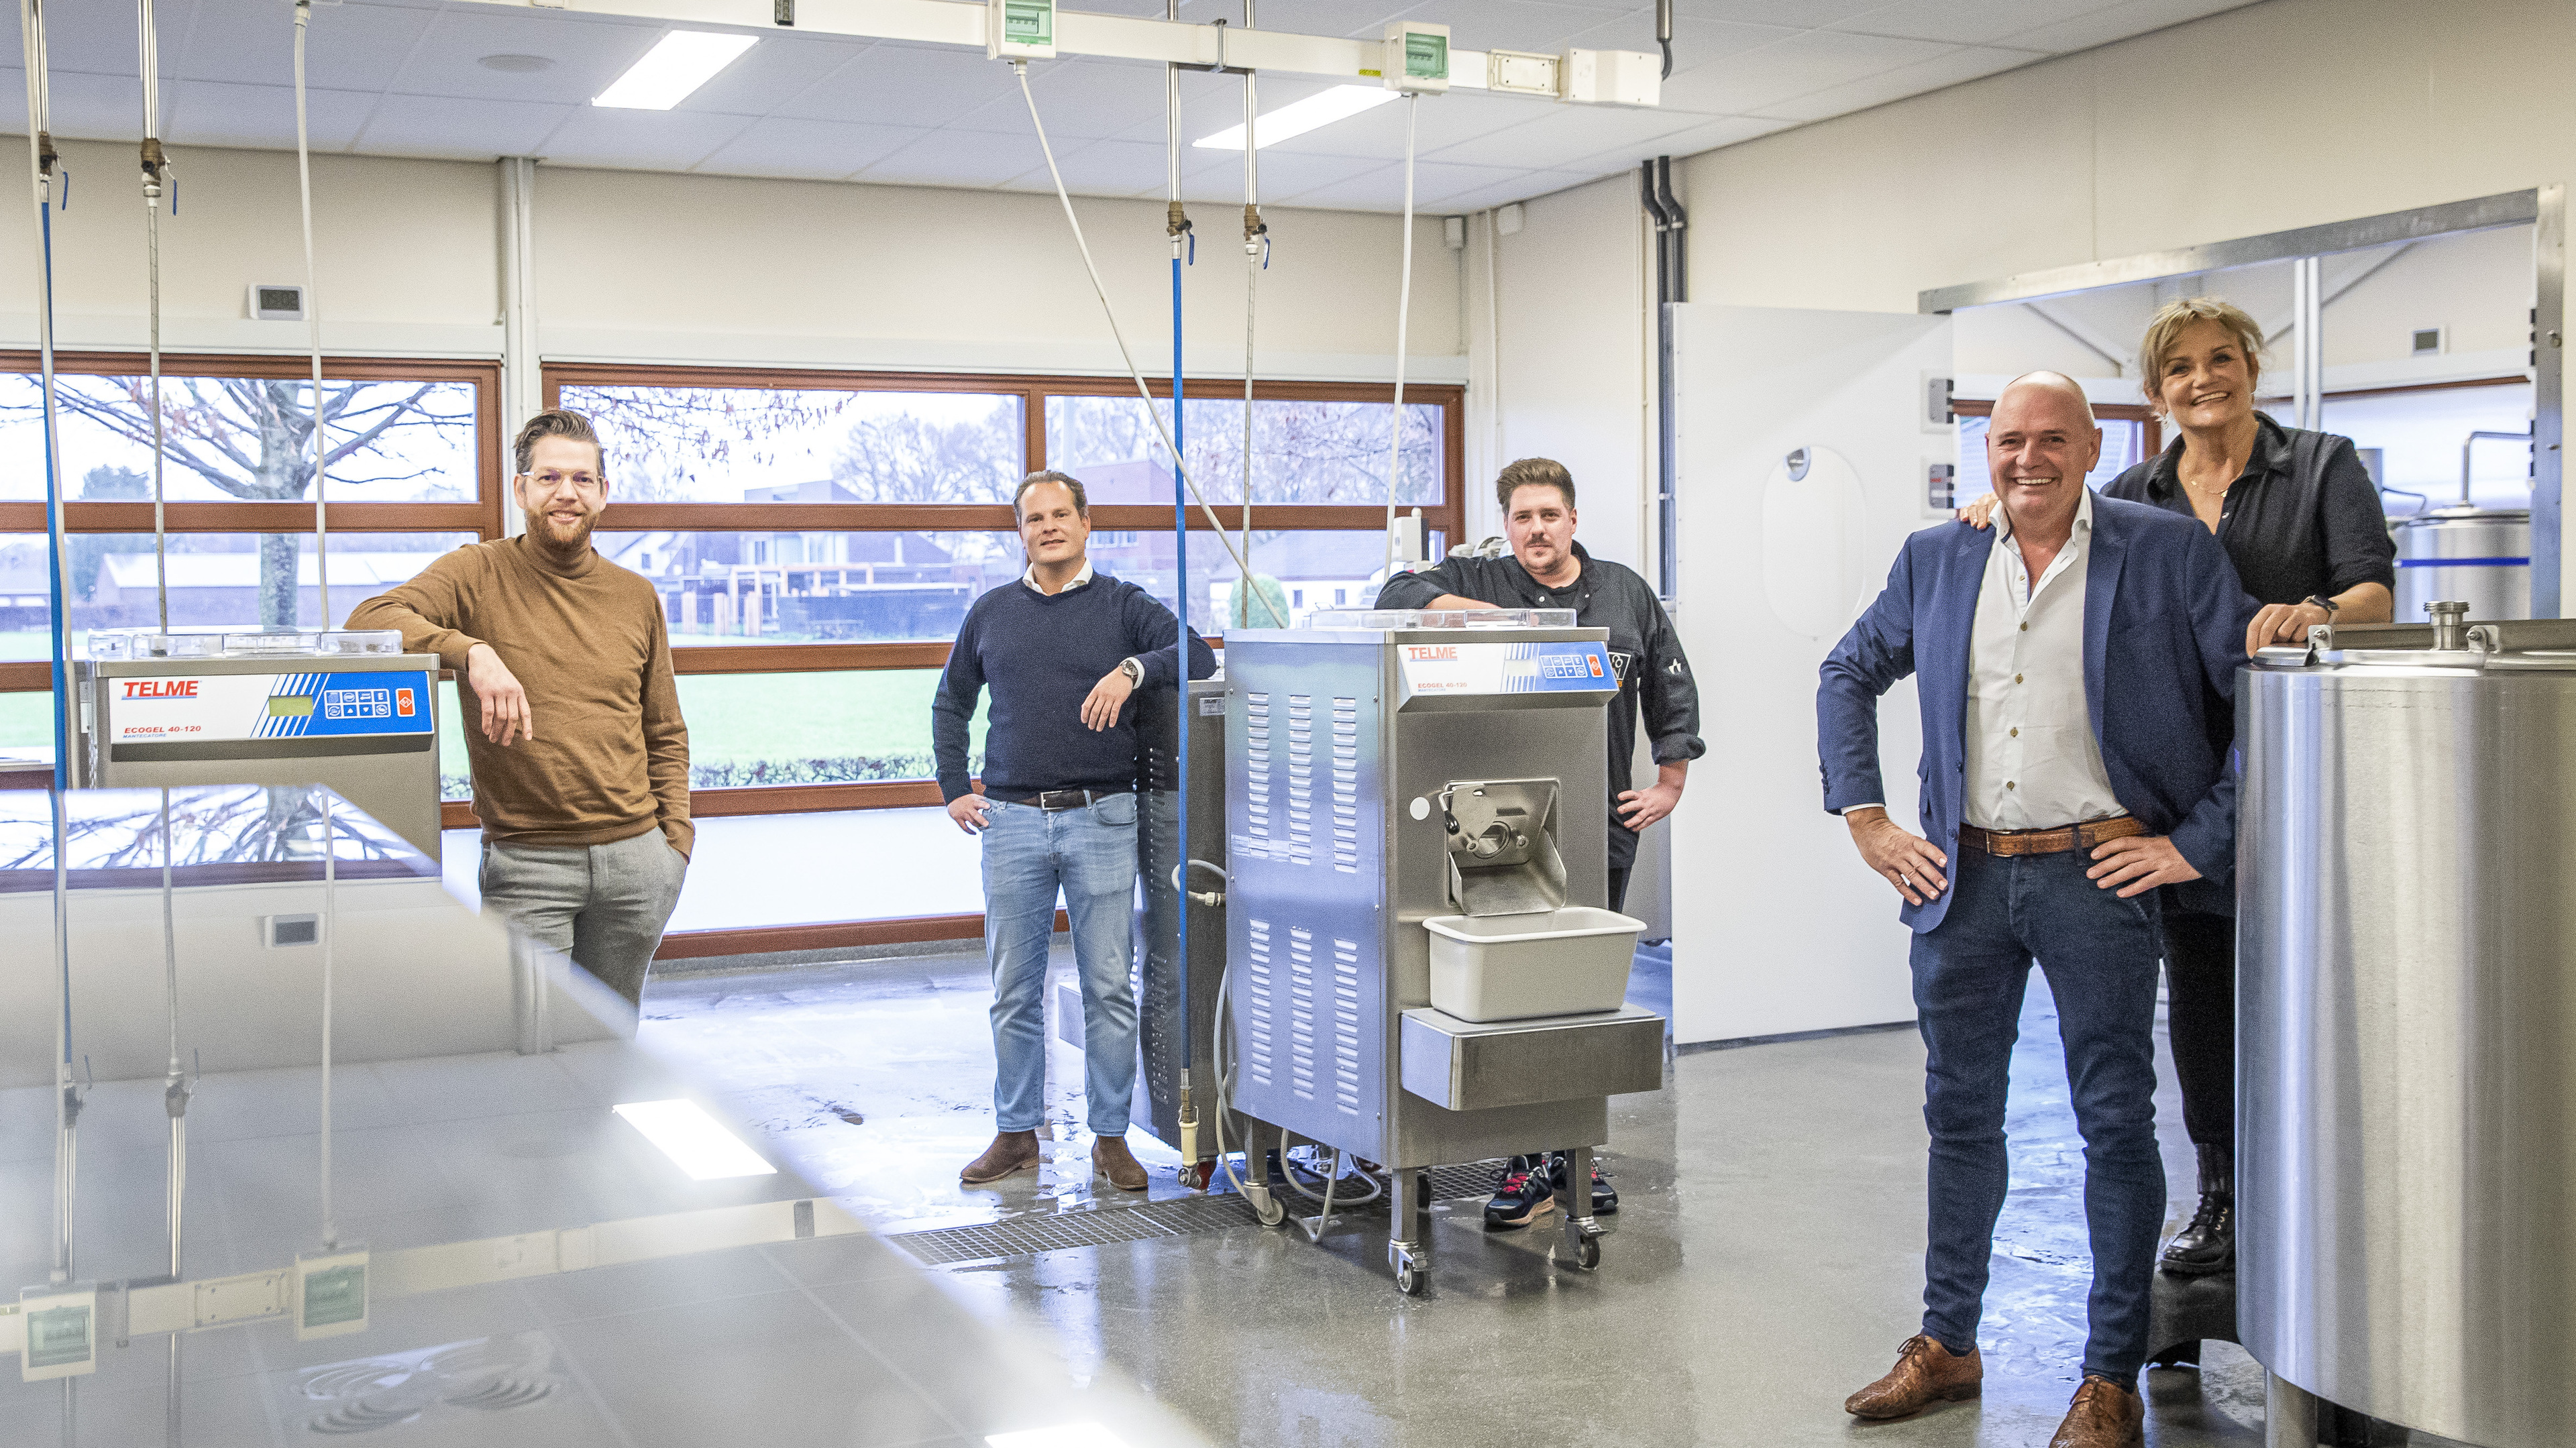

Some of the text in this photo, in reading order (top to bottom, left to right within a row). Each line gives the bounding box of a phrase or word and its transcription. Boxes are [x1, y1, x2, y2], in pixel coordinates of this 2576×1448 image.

[1408, 647, 1458, 659] TELME
[123, 681, 199, 698] TELME
[378, 692, 384, 700] E
